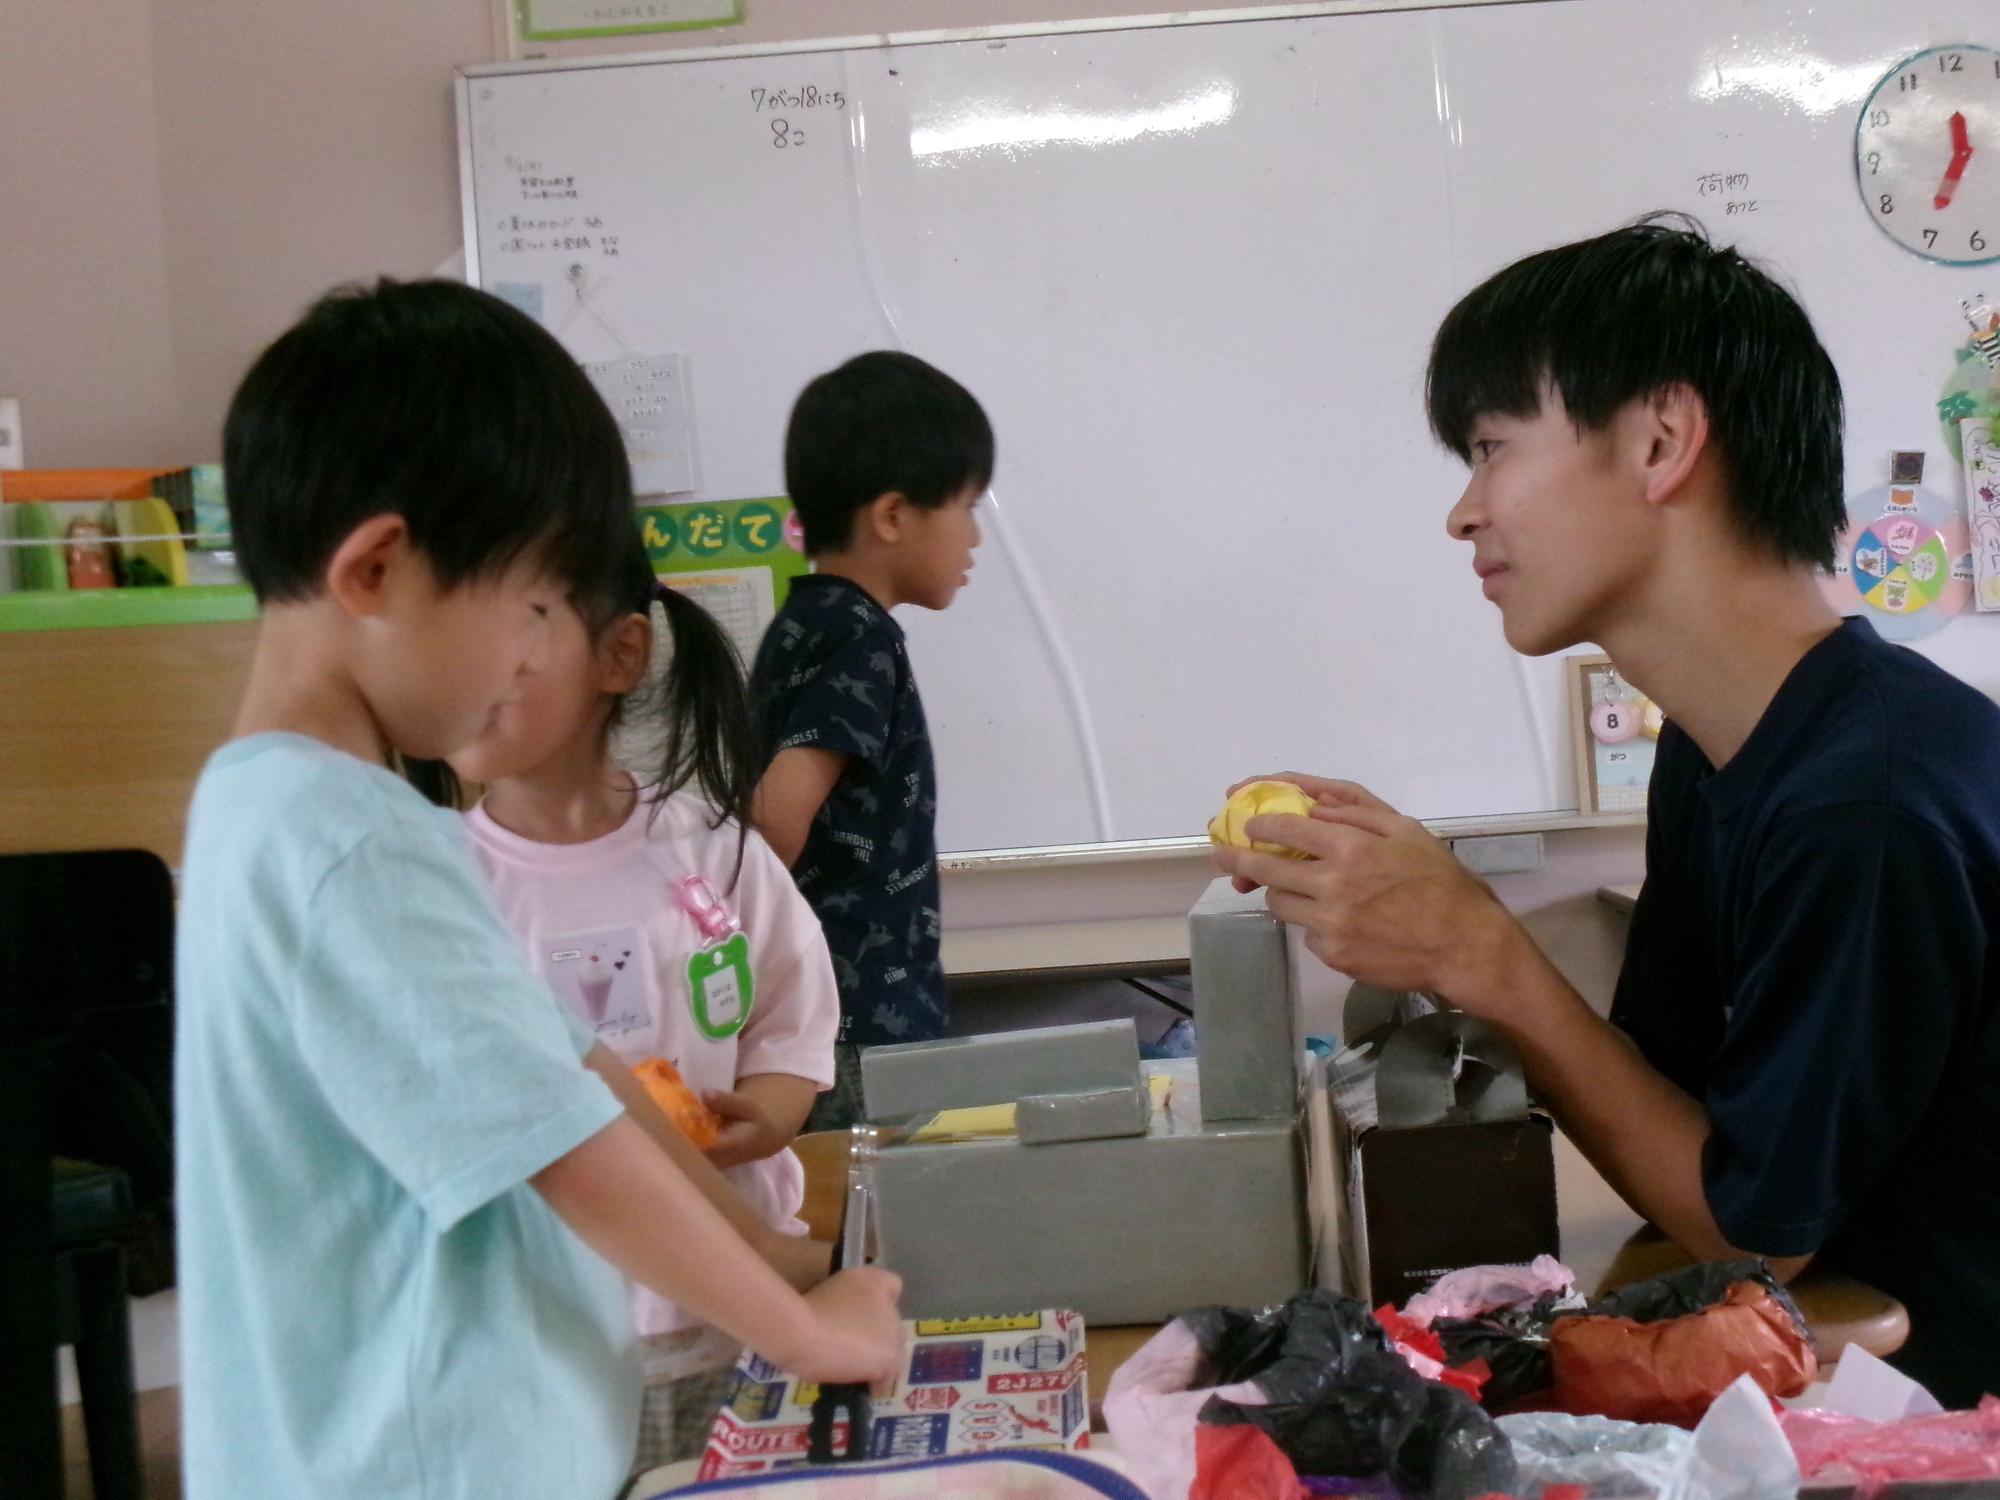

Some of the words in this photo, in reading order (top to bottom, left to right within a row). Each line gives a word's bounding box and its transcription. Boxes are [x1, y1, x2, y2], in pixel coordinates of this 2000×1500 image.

[1938, 54, 1963, 73] 12
[1900, 74, 1917, 91] 11
[750, 84, 846, 113] 7がつ18にち
[1870, 109, 1891, 129] 10
[770, 117, 806, 149] 8こ
[1866, 151, 1881, 175] 9
[1880, 193, 1893, 215] 8
[1922, 228, 1938, 249] 7
[1969, 230, 1986, 251] 6
[1606, 713, 1619, 729] 8
